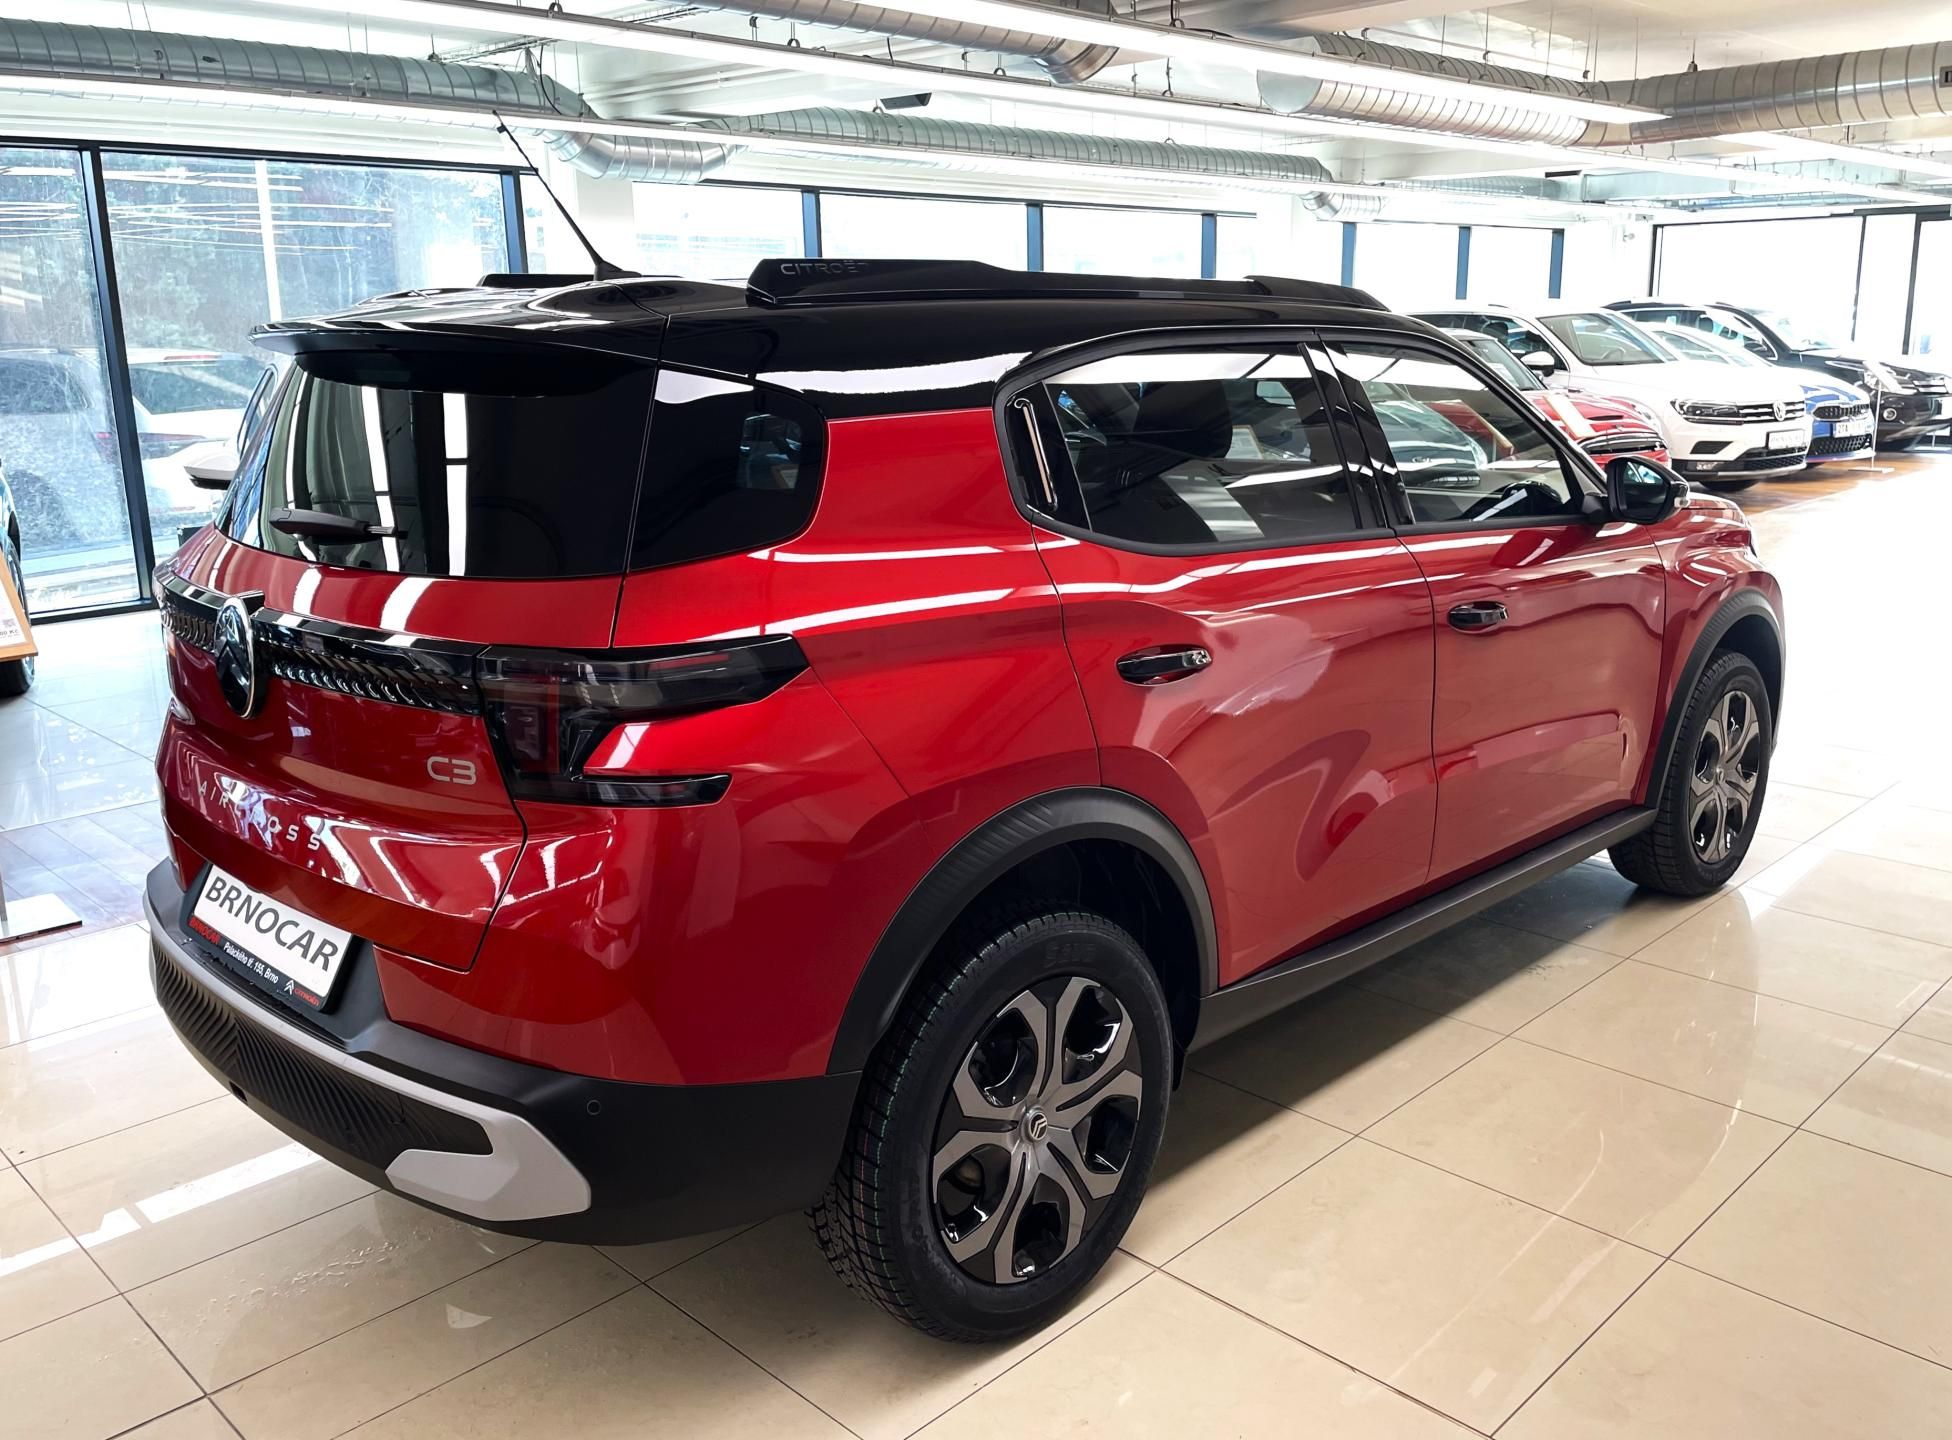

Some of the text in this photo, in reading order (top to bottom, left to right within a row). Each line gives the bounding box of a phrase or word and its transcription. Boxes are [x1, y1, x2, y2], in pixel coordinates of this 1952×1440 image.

[427, 756, 477, 785] C3
[200, 781, 321, 851] AIRCOSS
[205, 876, 339, 972] BRNOCAR
[253, 961, 265, 977] 155,
[263, 967, 279, 984] Brno
